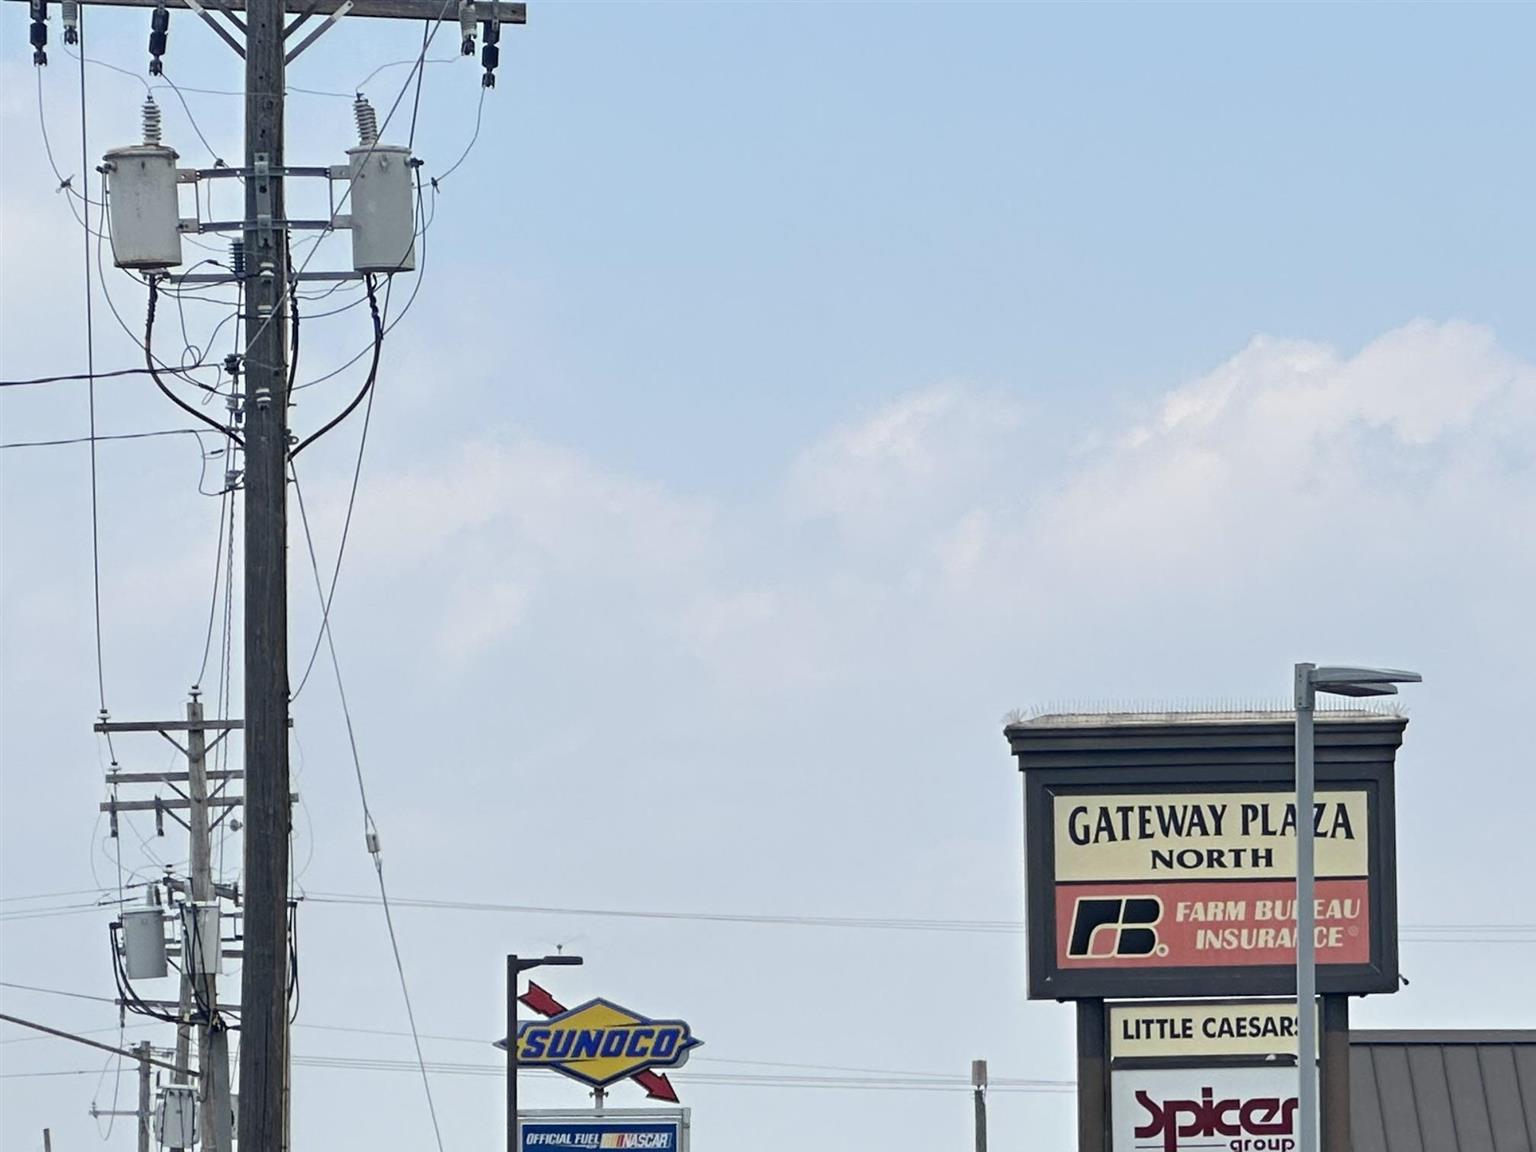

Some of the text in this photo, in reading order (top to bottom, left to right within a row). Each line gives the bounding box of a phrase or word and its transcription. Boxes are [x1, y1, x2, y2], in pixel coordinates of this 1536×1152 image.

[1067, 803, 1227, 846] GATEWAY
[1151, 848, 1274, 870] NORTH
[1176, 898, 1362, 922] FARM BUEAU
[1195, 927, 1344, 952] INSURACE
[1123, 1016, 1299, 1040] LITTLE CAESAR
[520, 1028, 682, 1058] SUNOCO
[526, 1132, 670, 1148] OFFICIAL FUEL NASCAR
